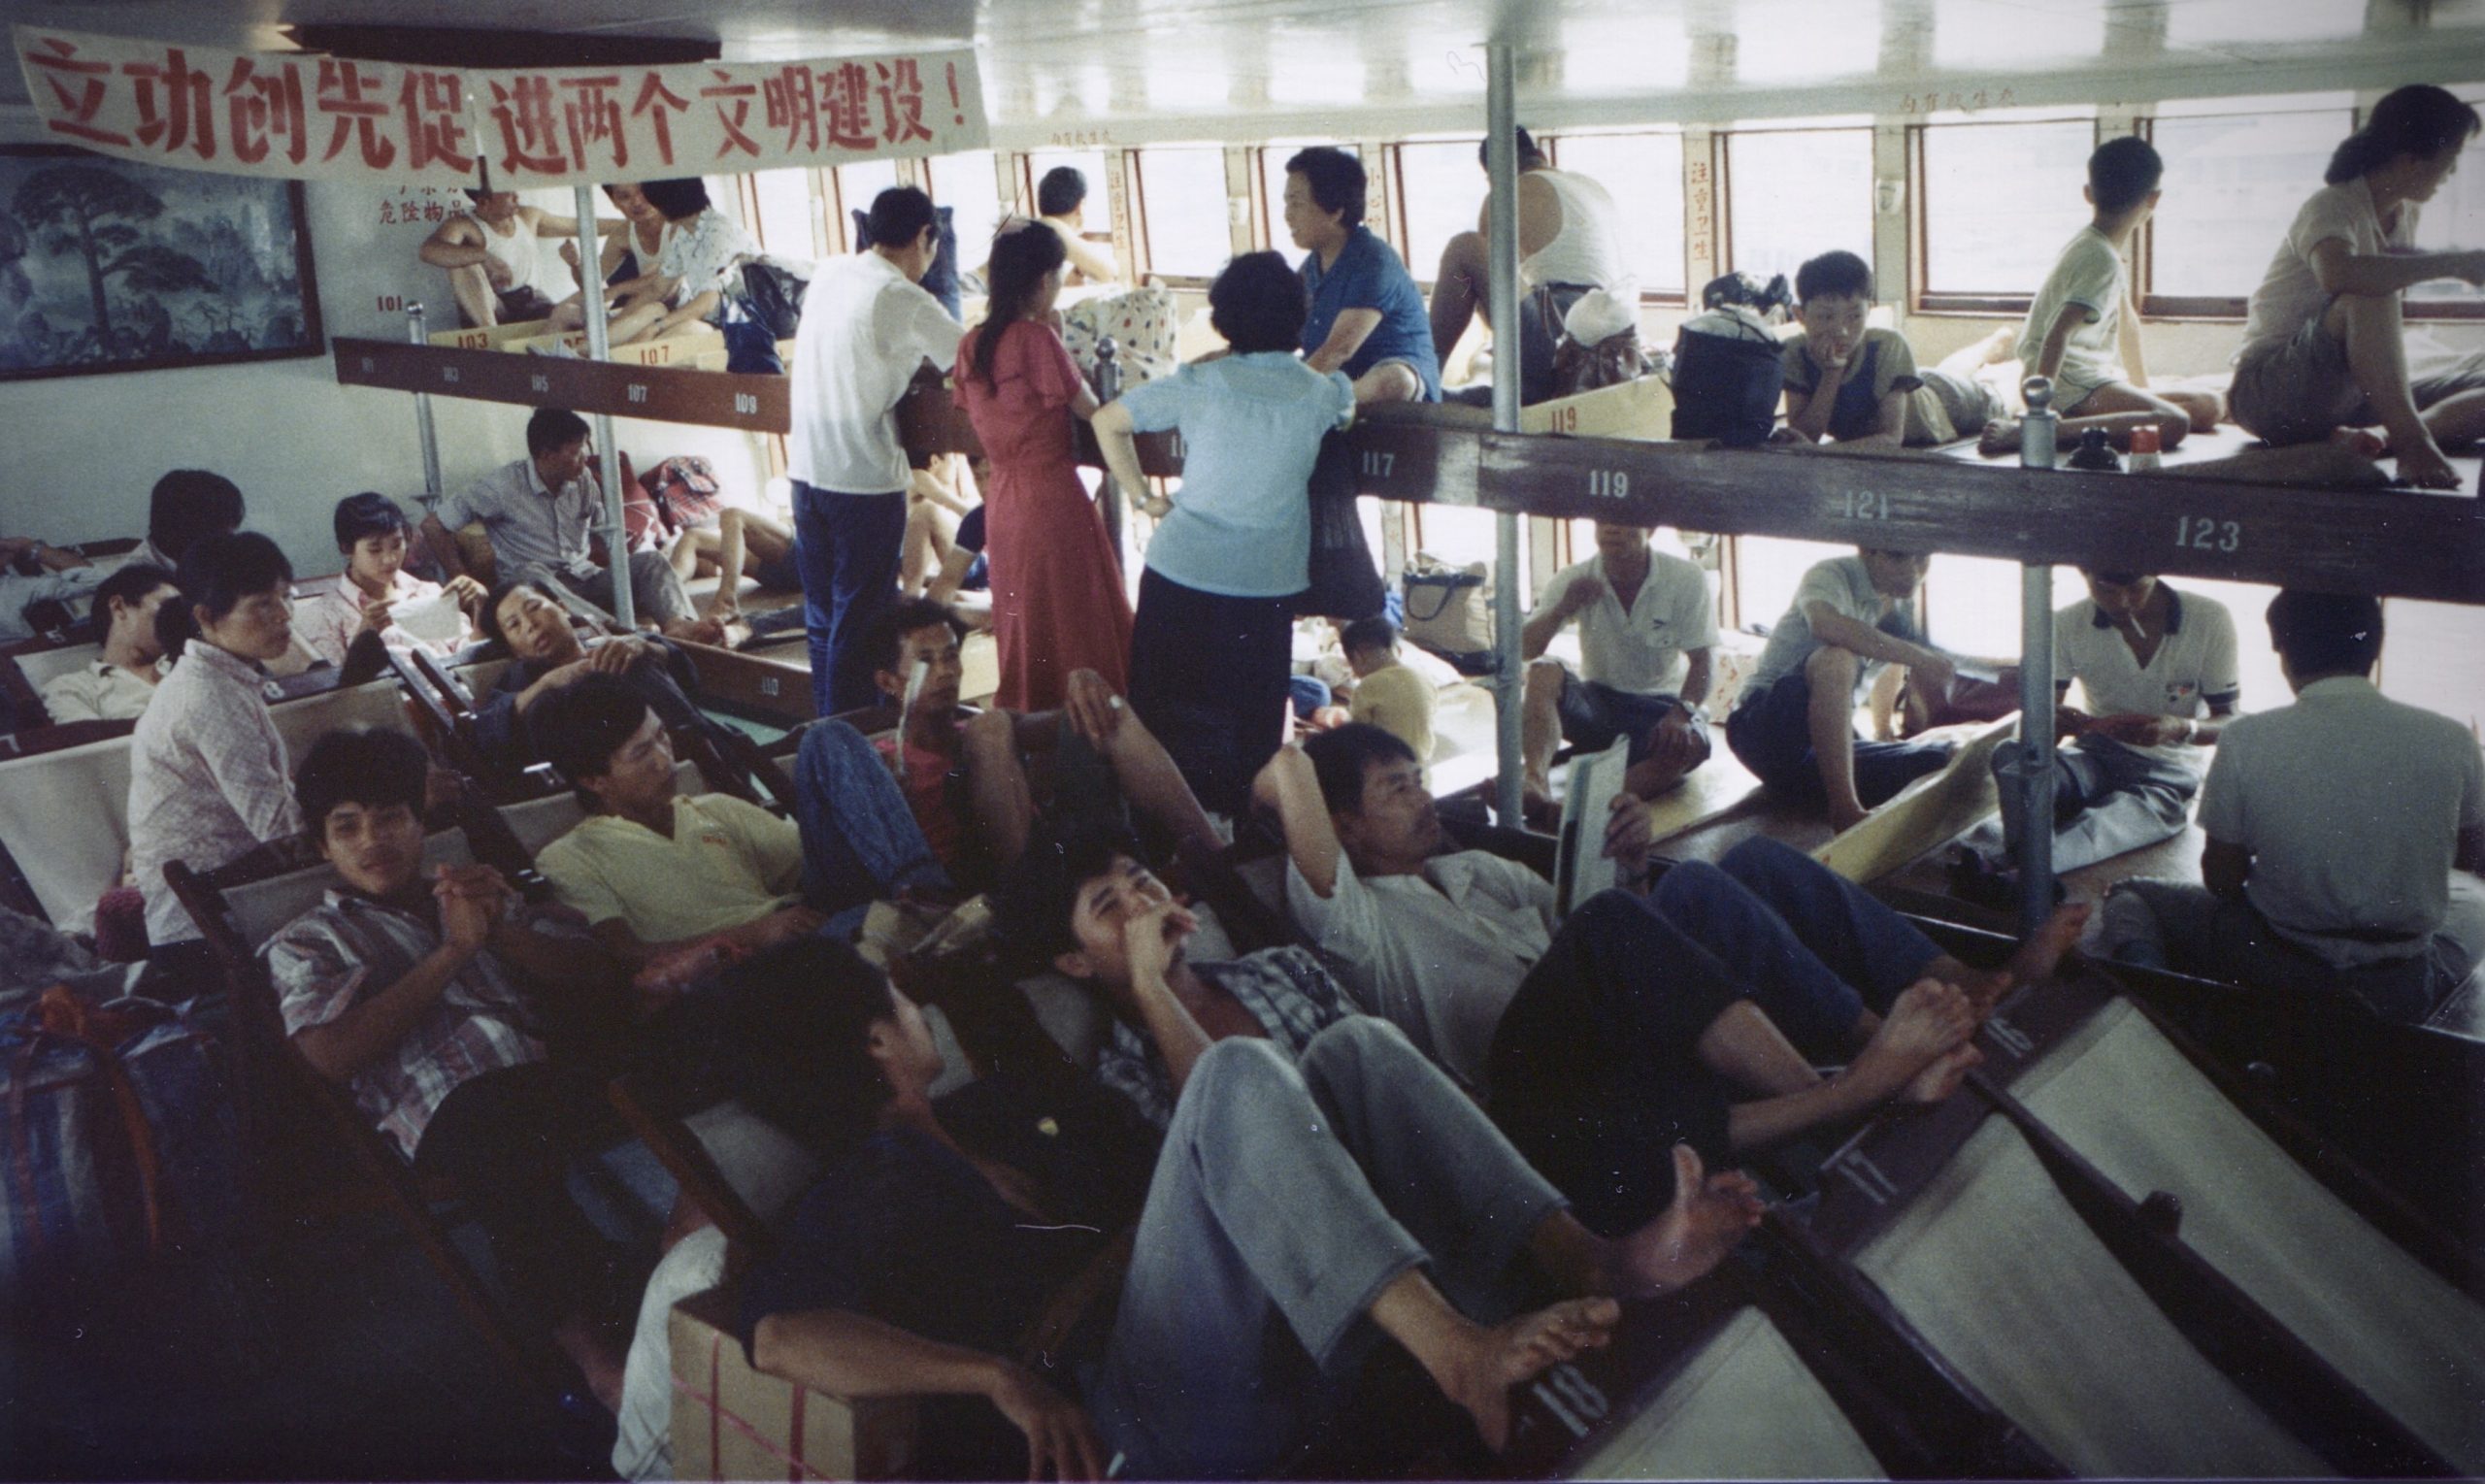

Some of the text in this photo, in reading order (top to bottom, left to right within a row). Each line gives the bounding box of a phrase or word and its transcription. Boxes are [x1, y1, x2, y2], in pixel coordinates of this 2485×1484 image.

[26, 37, 964, 175] 立功创先促进两个文明建设！
[377, 295, 402, 312] 101
[457, 332, 488, 349] 103
[641, 346, 670, 366] 107
[628, 383, 647, 403] 107
[735, 392, 757, 413] 109
[1551, 406, 1576, 434] 119
[1362, 449, 1395, 478] 117
[1589, 470, 1629, 498] 119
[1843, 490, 1890, 520] 121
[2175, 515, 2240, 552] 123
